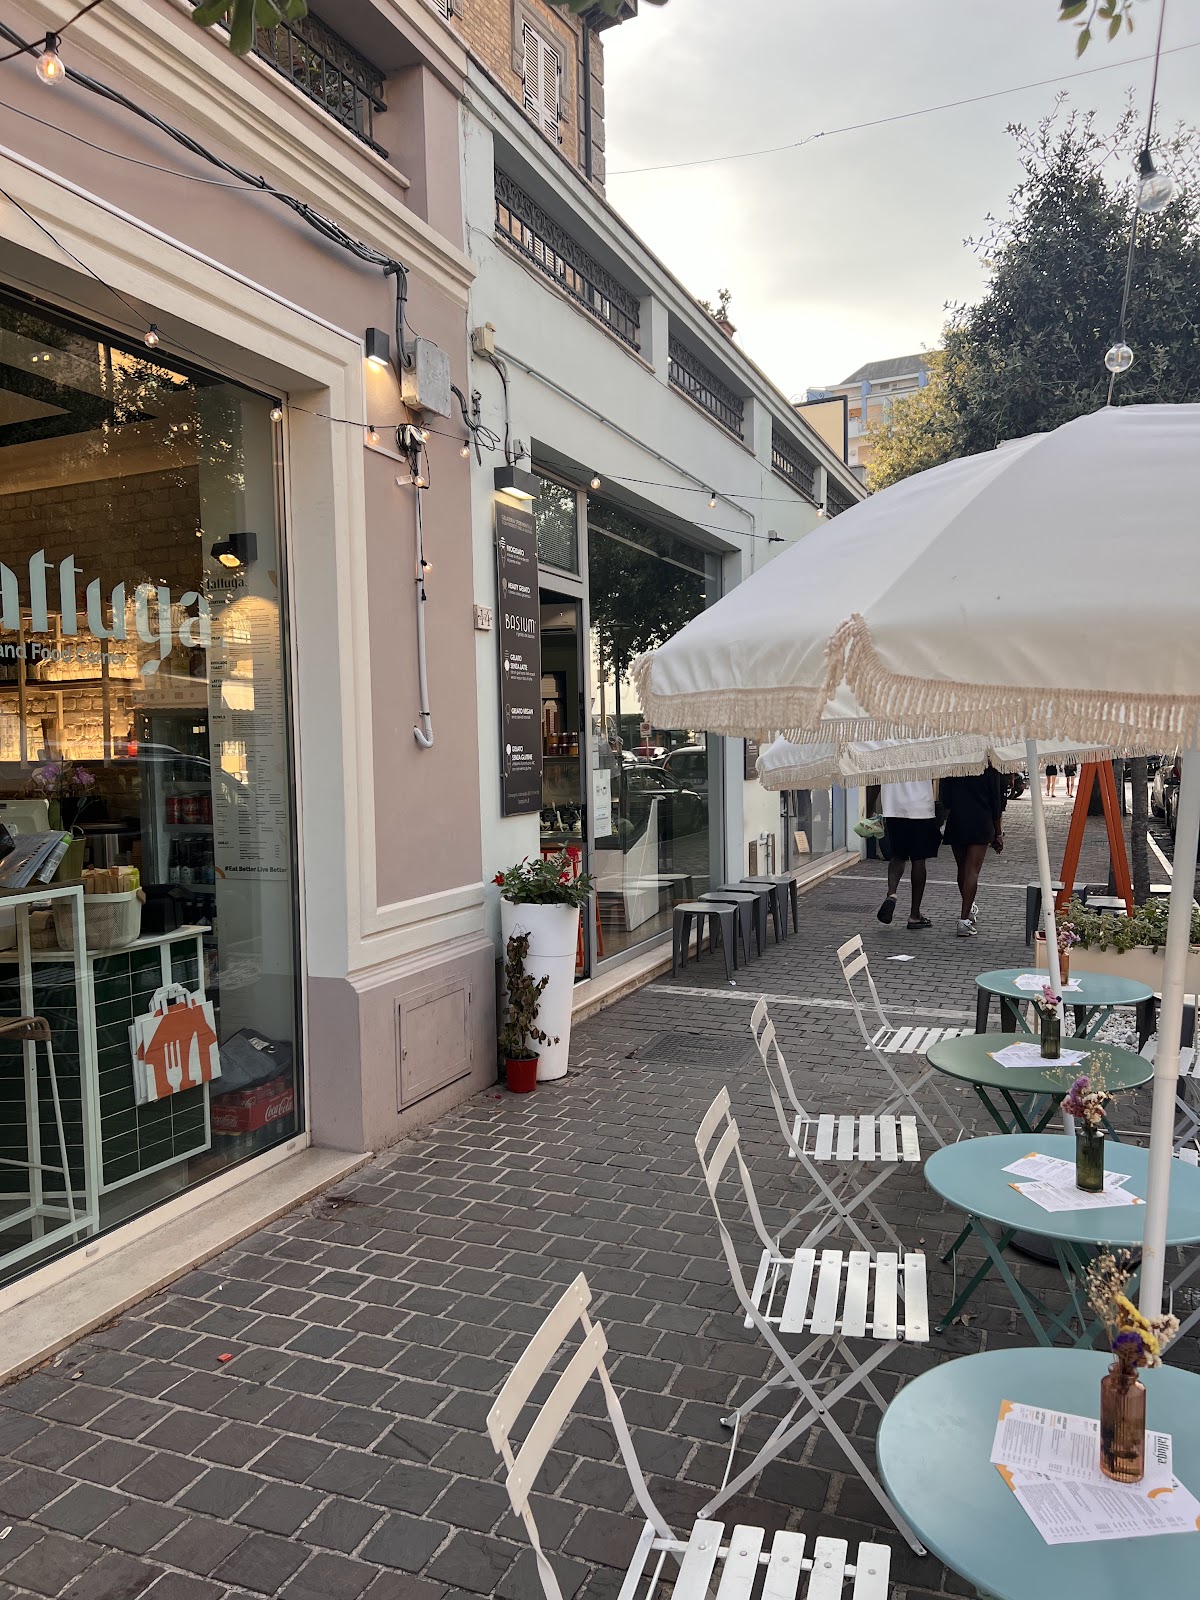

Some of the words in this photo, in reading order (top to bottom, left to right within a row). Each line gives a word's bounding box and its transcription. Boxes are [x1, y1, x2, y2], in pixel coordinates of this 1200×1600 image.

[505, 613, 535, 633] BASIUM
[0, 642, 27, 660] and
[31, 643, 72, 663] Food
[75, 646, 126, 666] Corner
